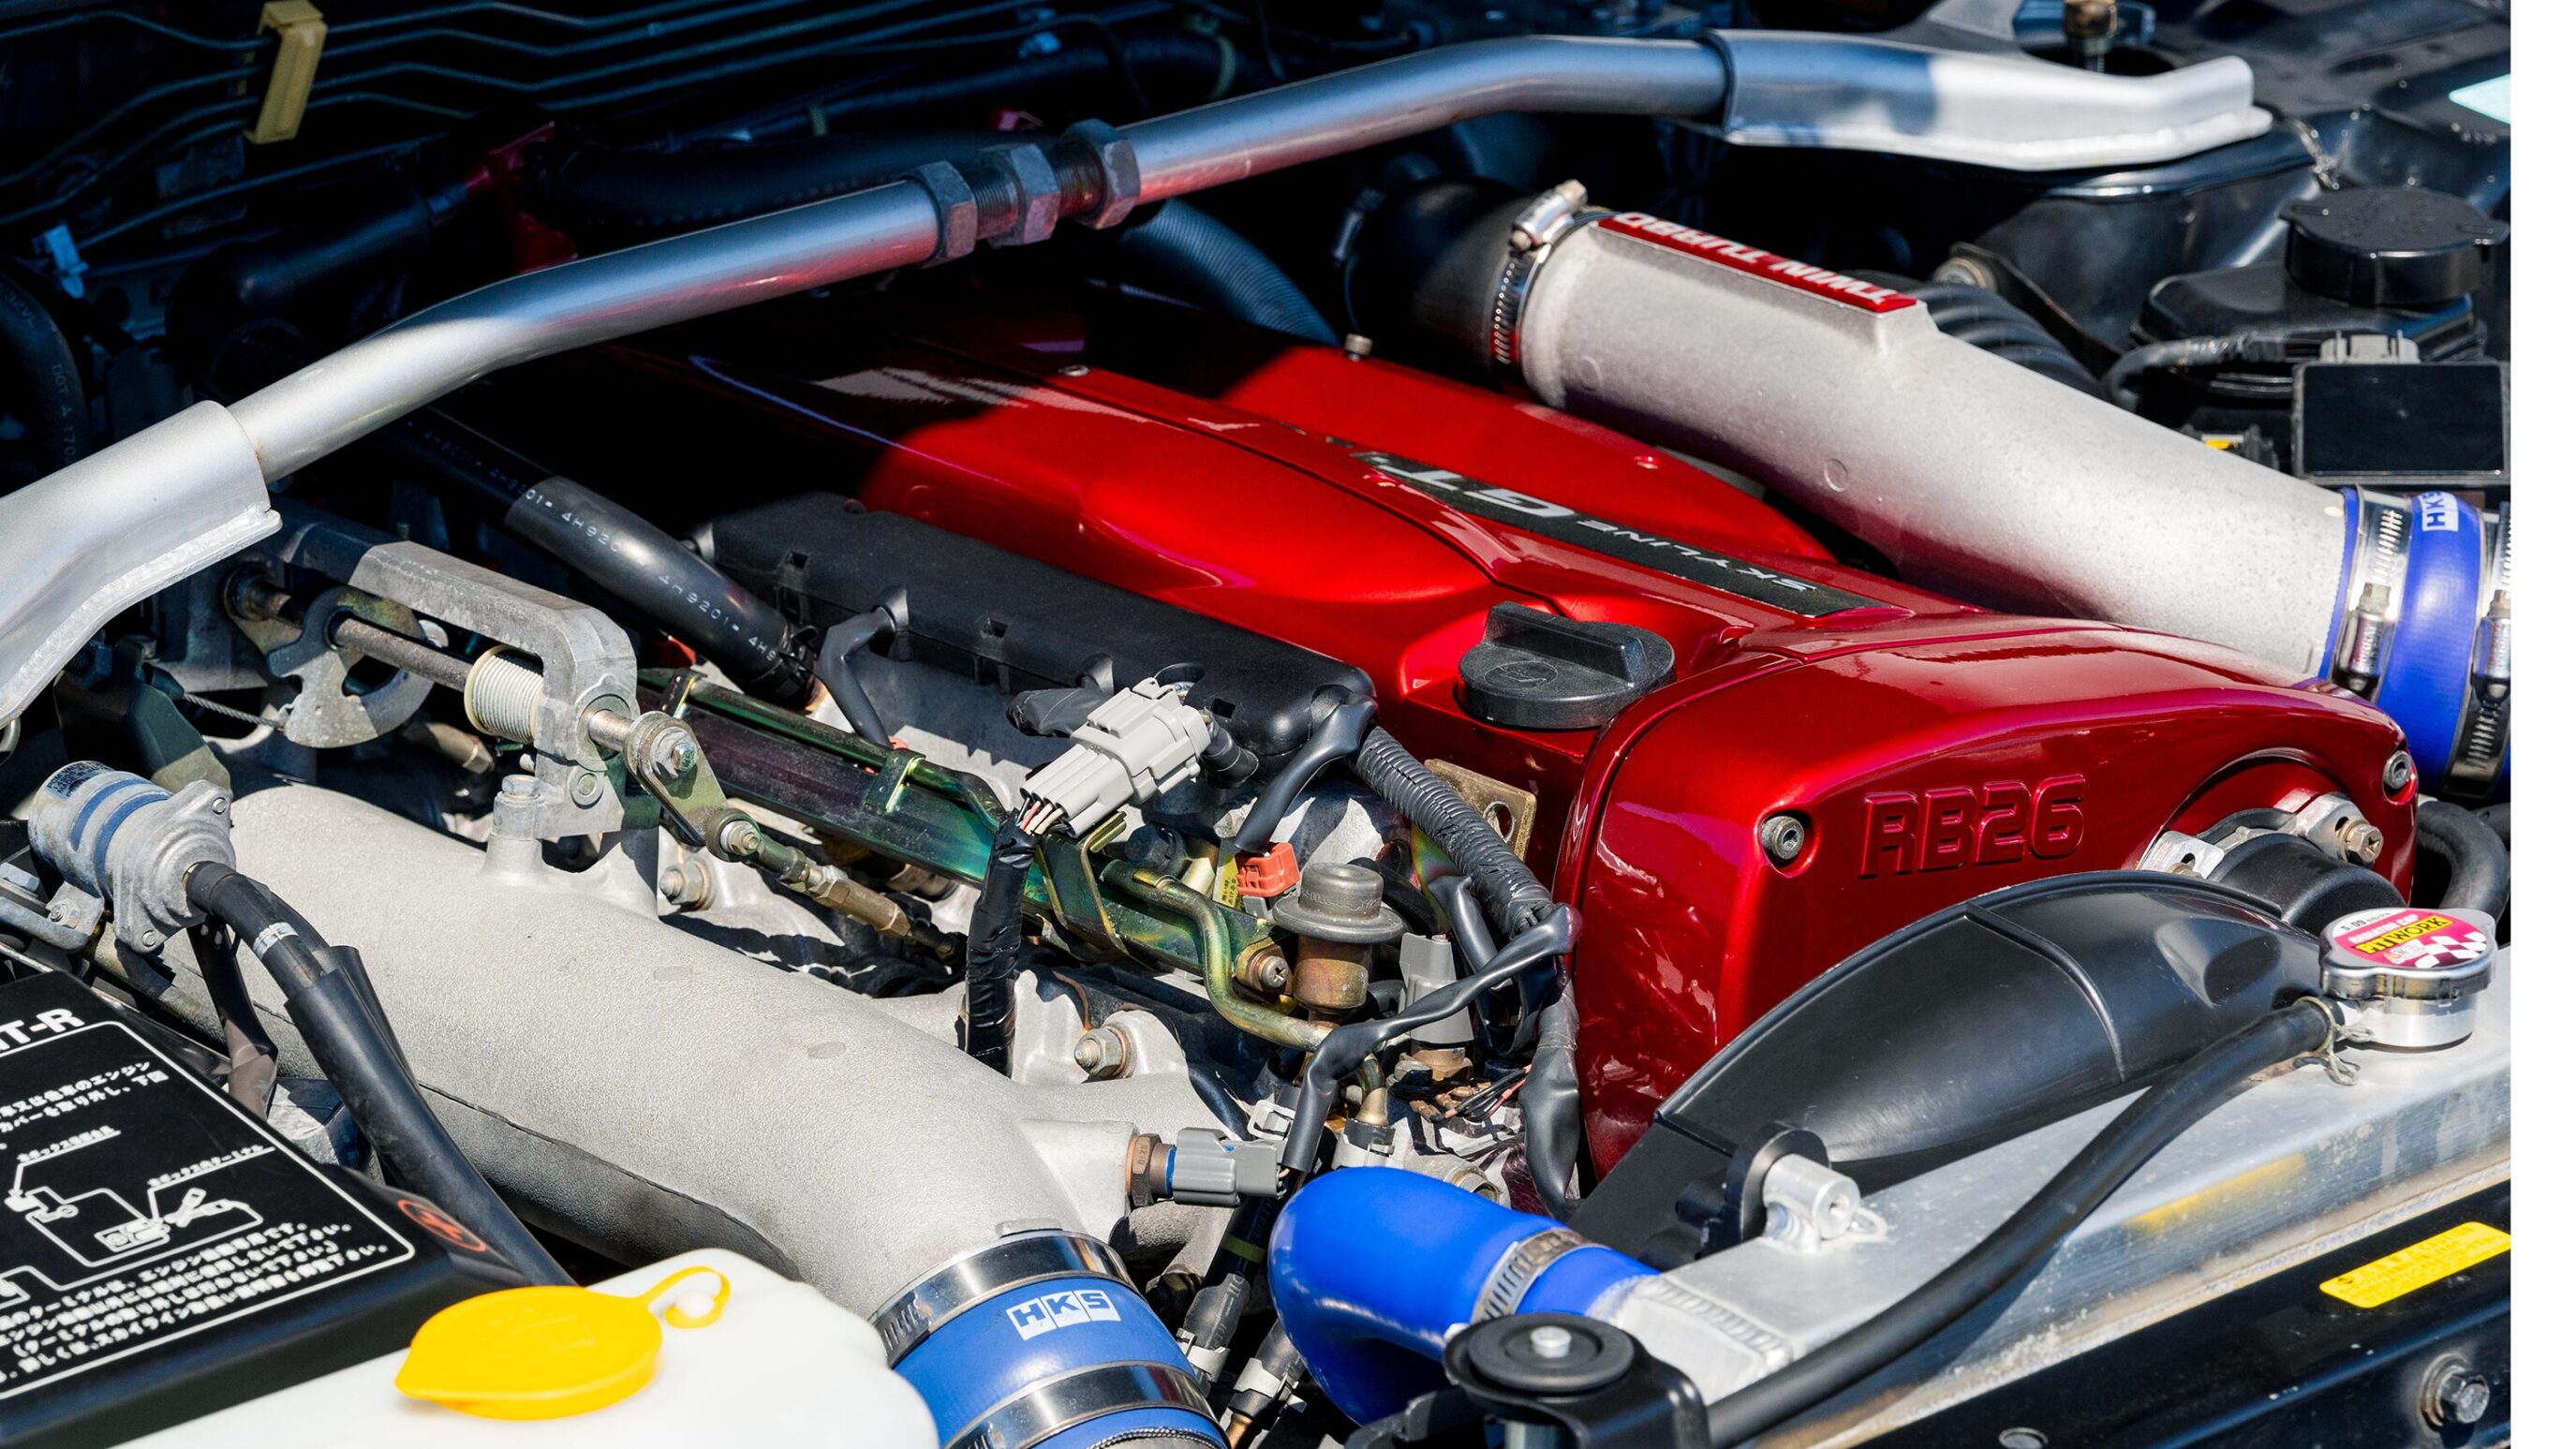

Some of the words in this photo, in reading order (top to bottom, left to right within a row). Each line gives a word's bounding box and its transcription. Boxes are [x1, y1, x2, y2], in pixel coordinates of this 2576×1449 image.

[1614, 212, 1770, 264] TURBO
[1769, 258, 1899, 304] TWIN
[562, 511, 621, 553] 4H920
[1577, 518, 1818, 593] SKYLINE
[1858, 773, 2085, 880] RB26
[2354, 916, 2449, 954] PITWORK
[0, 1009, 85, 1051] T-R
[1010, 1290, 1116, 1334] HKS
